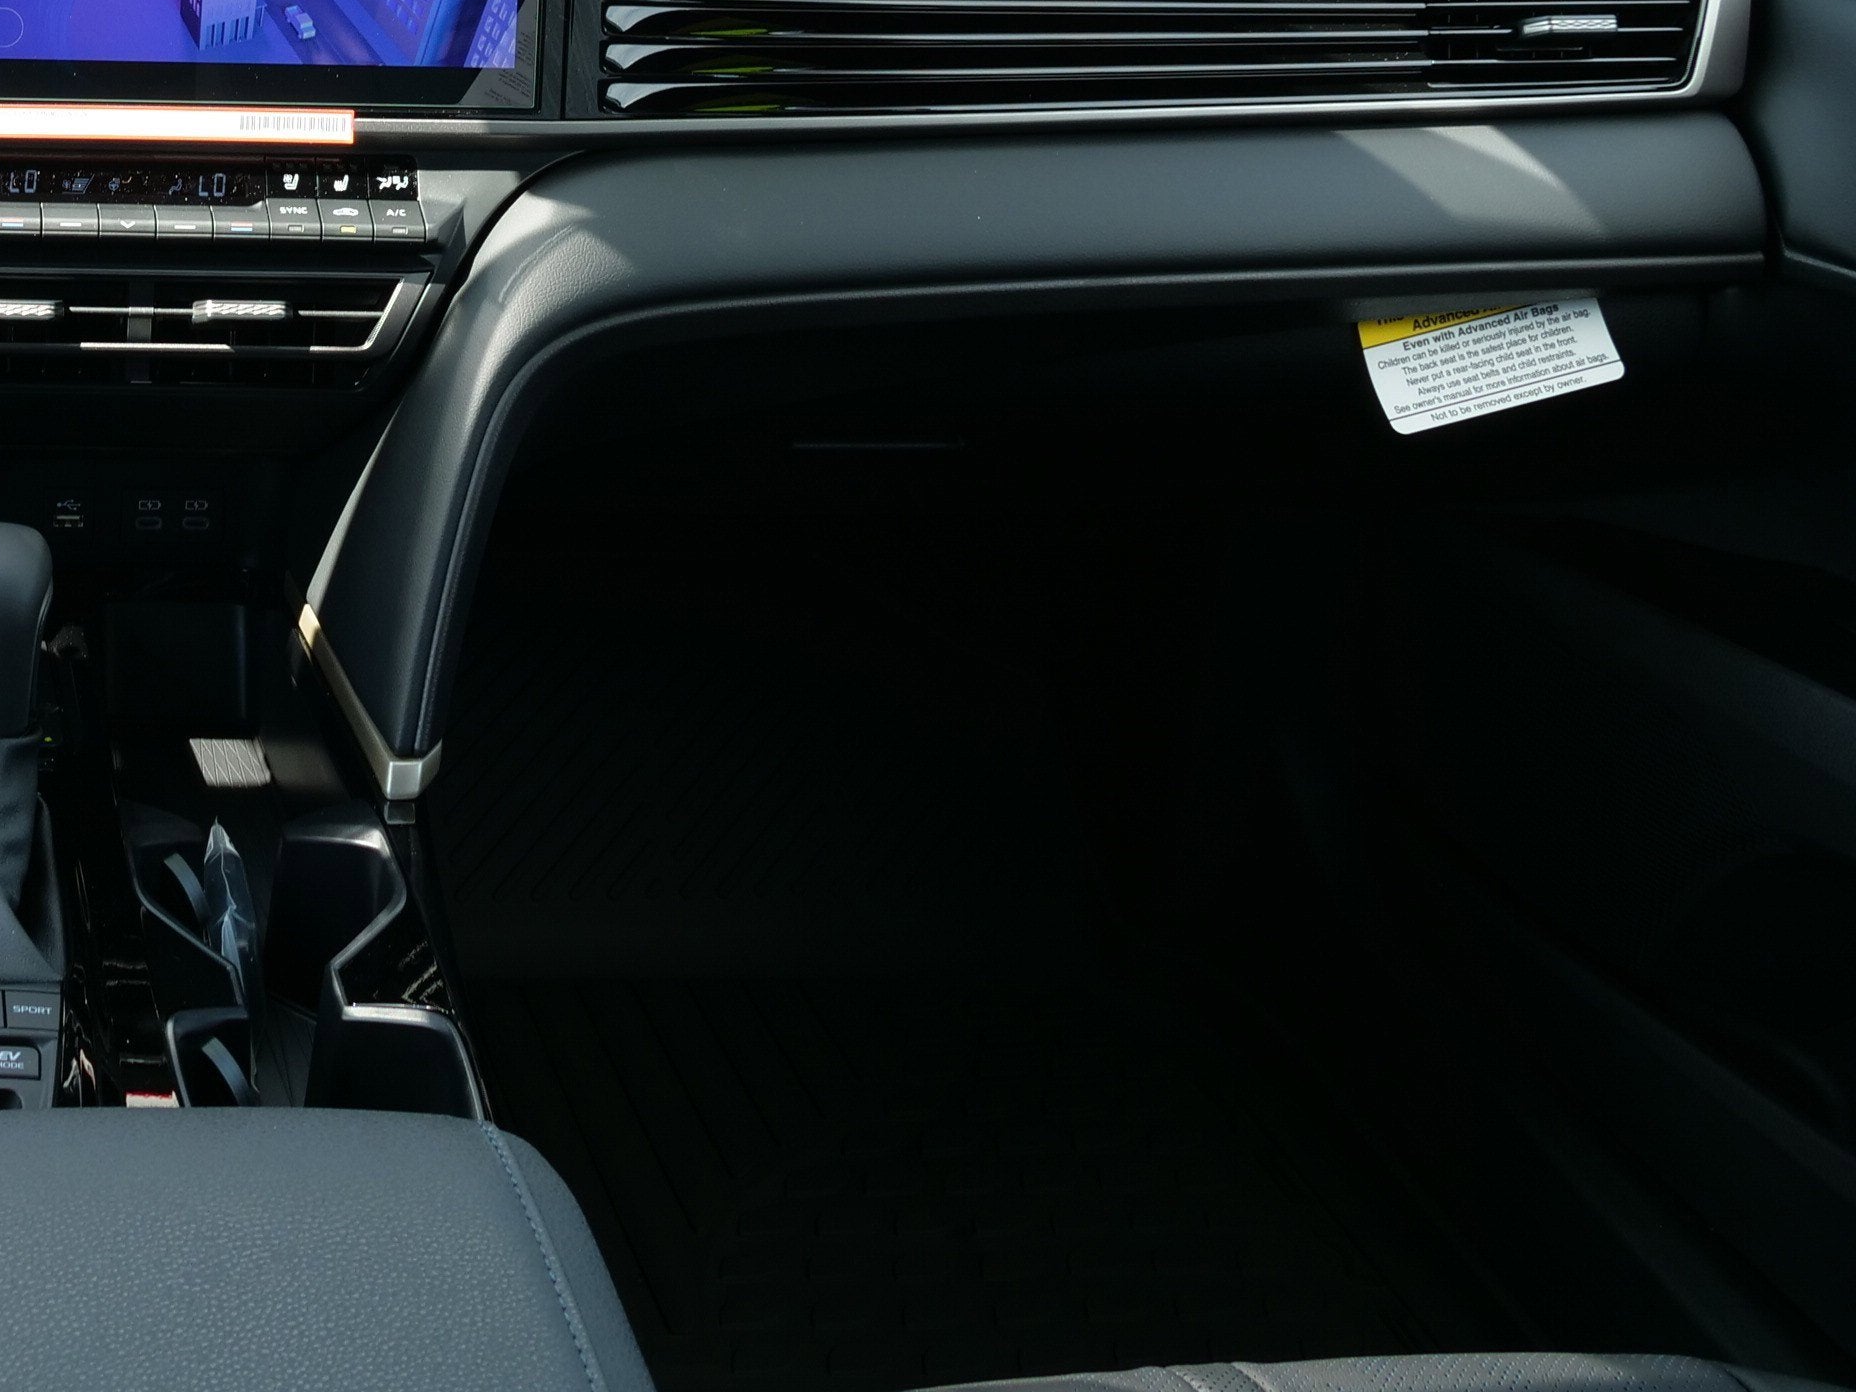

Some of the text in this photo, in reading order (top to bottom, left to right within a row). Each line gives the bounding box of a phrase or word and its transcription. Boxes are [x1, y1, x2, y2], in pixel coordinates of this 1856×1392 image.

[279, 206, 308, 215] SYNC
[386, 209, 407, 217] A/C
[1377, 308, 1591, 370] Children can be killed or seriously injured by the air bag.
[1402, 366, 1418, 376] The
[1419, 360, 1437, 370] back
[1439, 355, 1457, 366] seat
[1466, 348, 1480, 358] the
[1481, 340, 1505, 355] safest
[1505, 337, 1527, 351] place
[1527, 331, 1539, 342] for
[1540, 325, 1574, 339] children.
[1403, 339, 1430, 351] Even
[1433, 330, 1455, 344] with
[1458, 316, 1511, 337] Advanced
[1513, 308, 1529, 322] Air
[1531, 303, 1559, 318] Bags
[1393, 352, 1610, 414] See owner's manual for more information about air bags.
[1405, 375, 1430, 387] Never
[1431, 370, 1445, 382] put
[1452, 358, 1495, 375] rear-facing
[1495, 350, 1515, 364] child
[1515, 348, 1533, 359] seat
[1534, 345, 1542, 353] in
[1542, 341, 1556, 352] the
[1556, 335, 1578, 348] front.
[1417, 350, 1577, 396] Always use seat belts and child restraints.
[1430, 375, 1588, 422] Not to be removed except by owner.
[13, 1005, 53, 1016] SPORT
